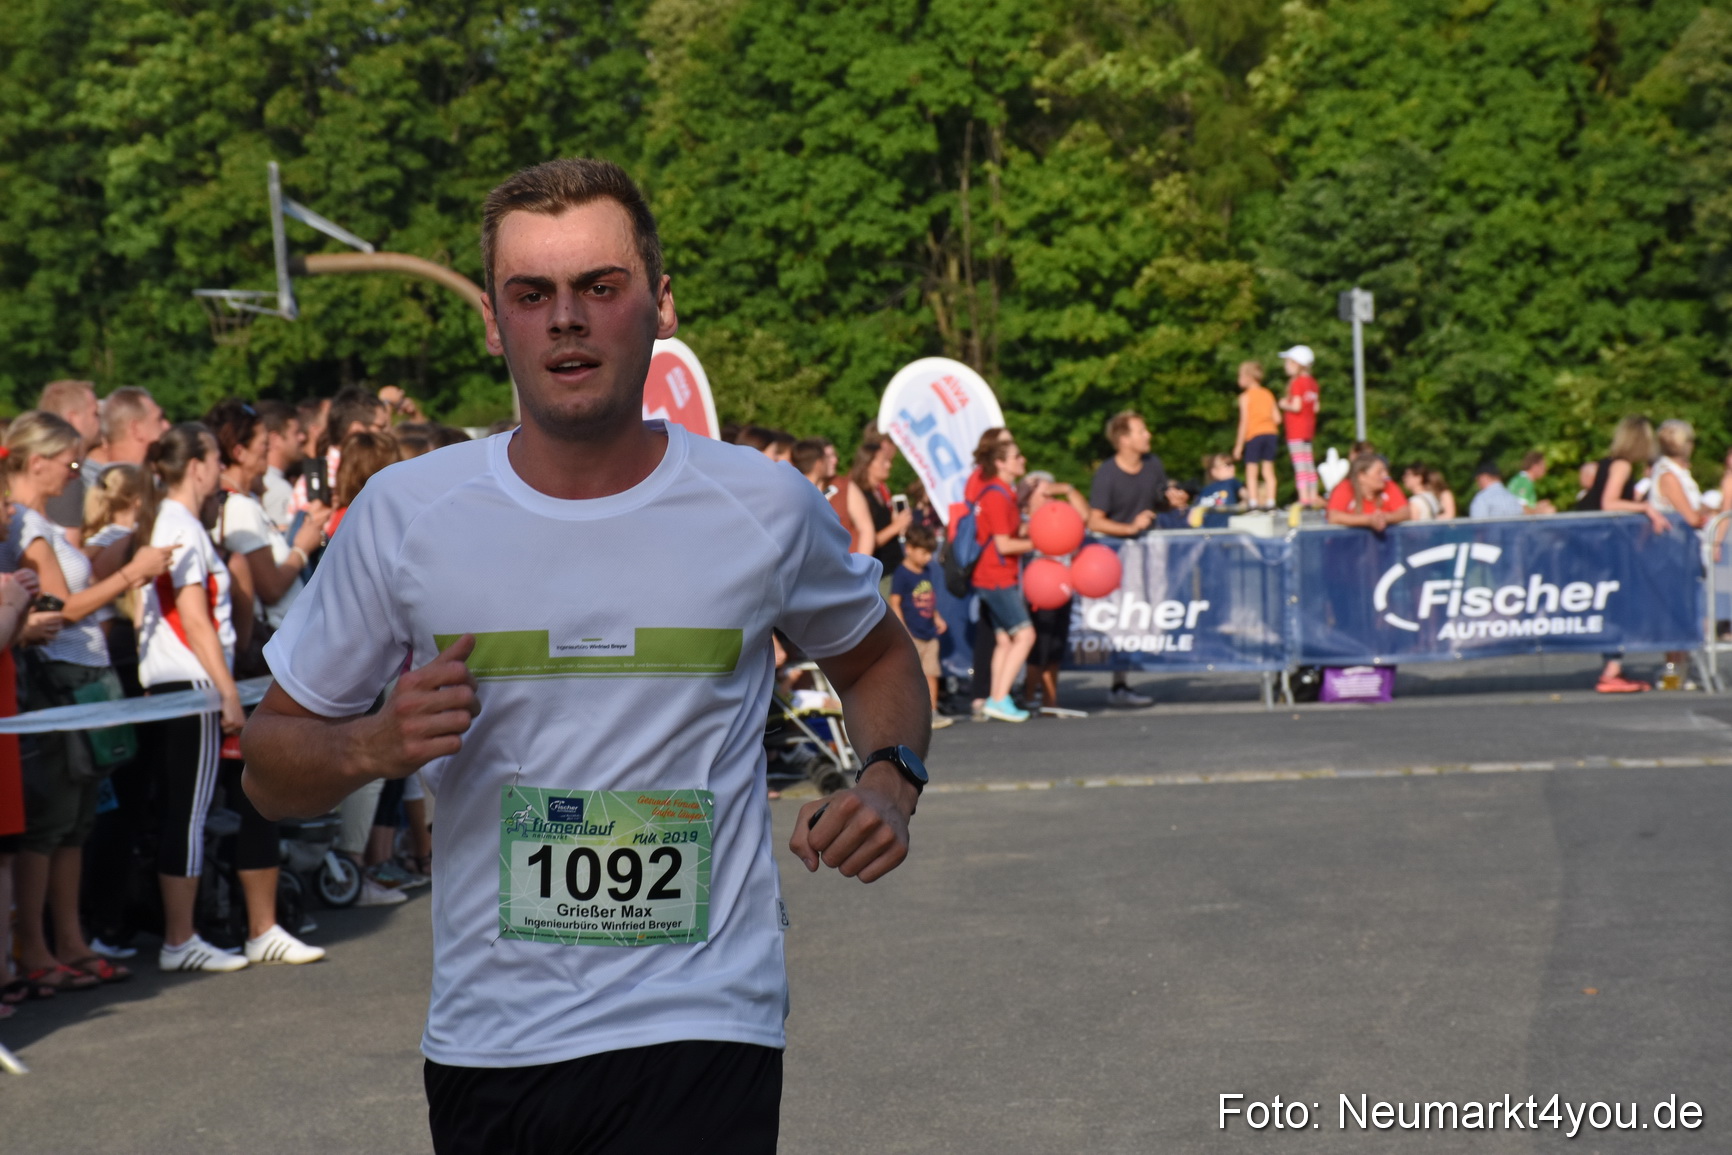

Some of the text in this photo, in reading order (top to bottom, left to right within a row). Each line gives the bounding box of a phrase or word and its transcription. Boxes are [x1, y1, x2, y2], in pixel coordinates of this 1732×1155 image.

[1418, 574, 1620, 619] Fischer
[1437, 615, 1604, 641] AUTOMOBILE
[532, 818, 616, 836] firmenlauf
[662, 831, 698, 844] 2019
[527, 844, 683, 902] 1092
[556, 903, 652, 918] Grießer Max
[524, 916, 682, 931] Ingenieurbüro Winfried Breyer
